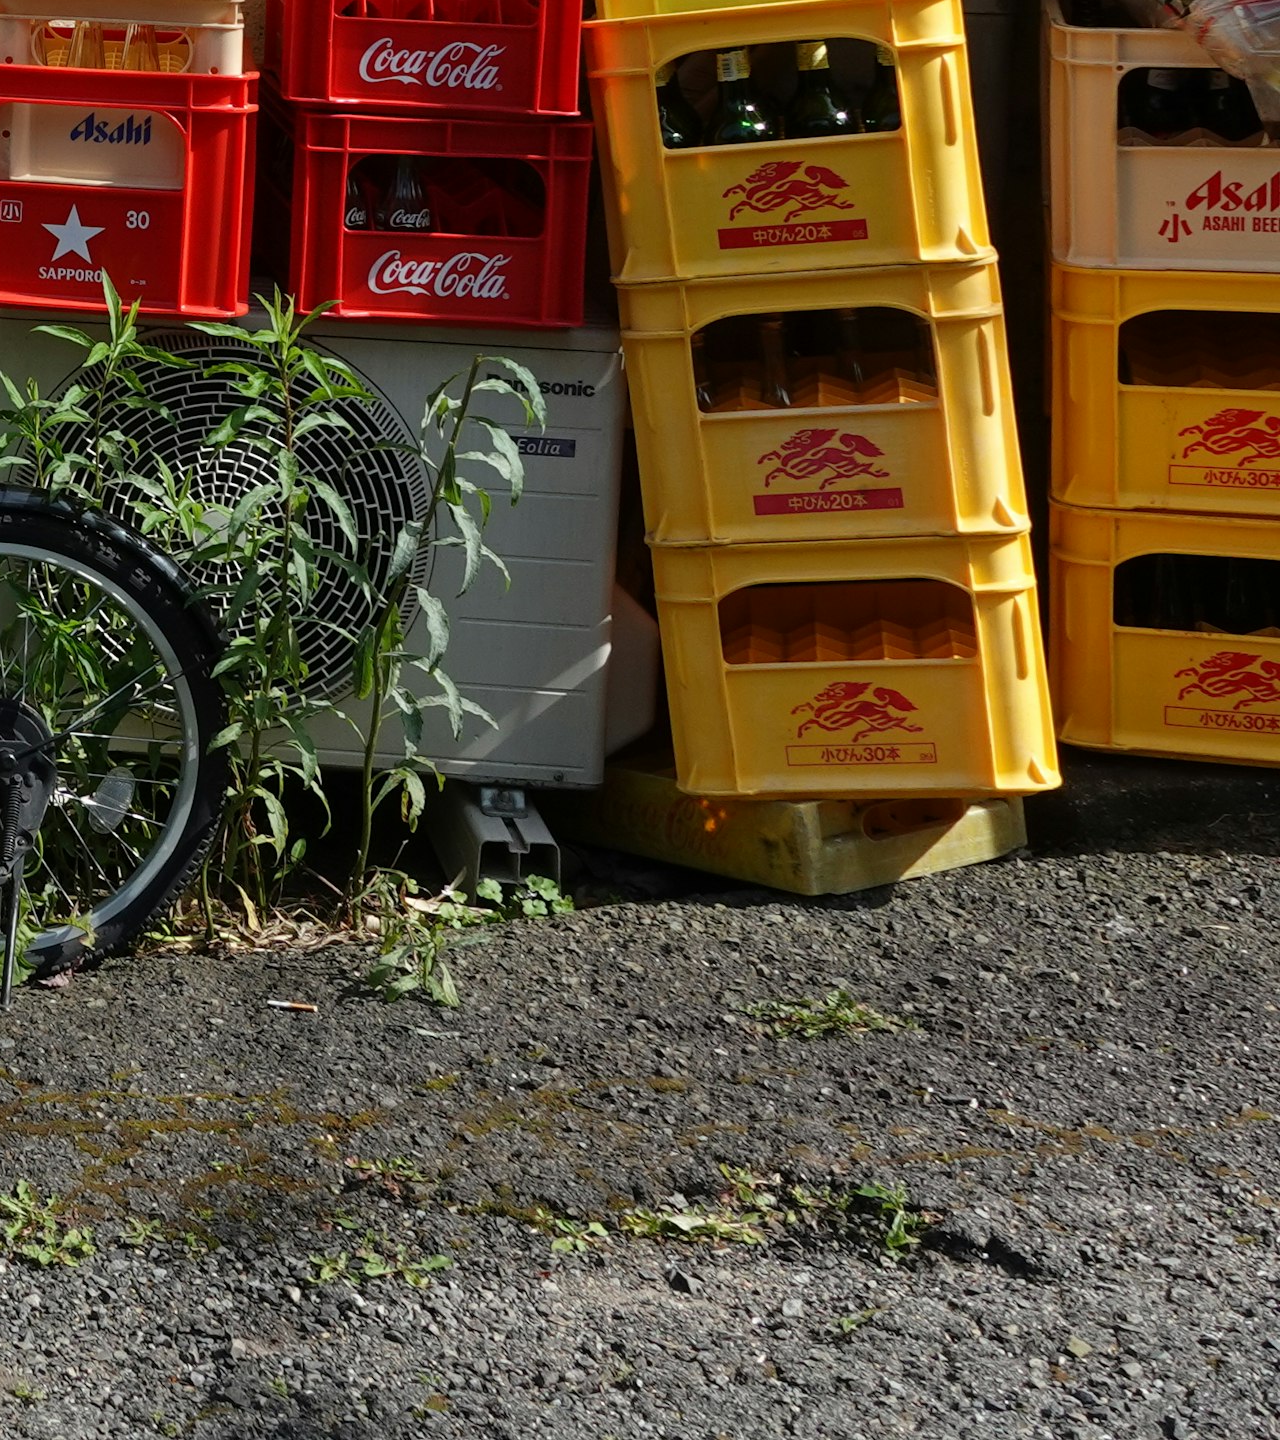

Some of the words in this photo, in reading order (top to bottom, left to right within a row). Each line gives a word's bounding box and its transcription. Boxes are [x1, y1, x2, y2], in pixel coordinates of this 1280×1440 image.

[359, 37, 507, 91] Coca-Cola
[70, 112, 152, 145] Asahi
[3, 203, 20, 219] 小
[125, 210, 150, 229] 30
[1158, 213, 1193, 243] 小
[1202, 216, 1245, 232] ASAHI
[1252, 217, 1280, 232] BEE
[752, 225, 833, 244] 中びん20本
[38, 266, 104, 283] SAPPORO
[367, 249, 513, 299] Coca-Cola
[517, 438, 561, 455] Eolia
[788, 493, 868, 511] 中びん20本
[821, 746, 901, 763] 小びん30本
